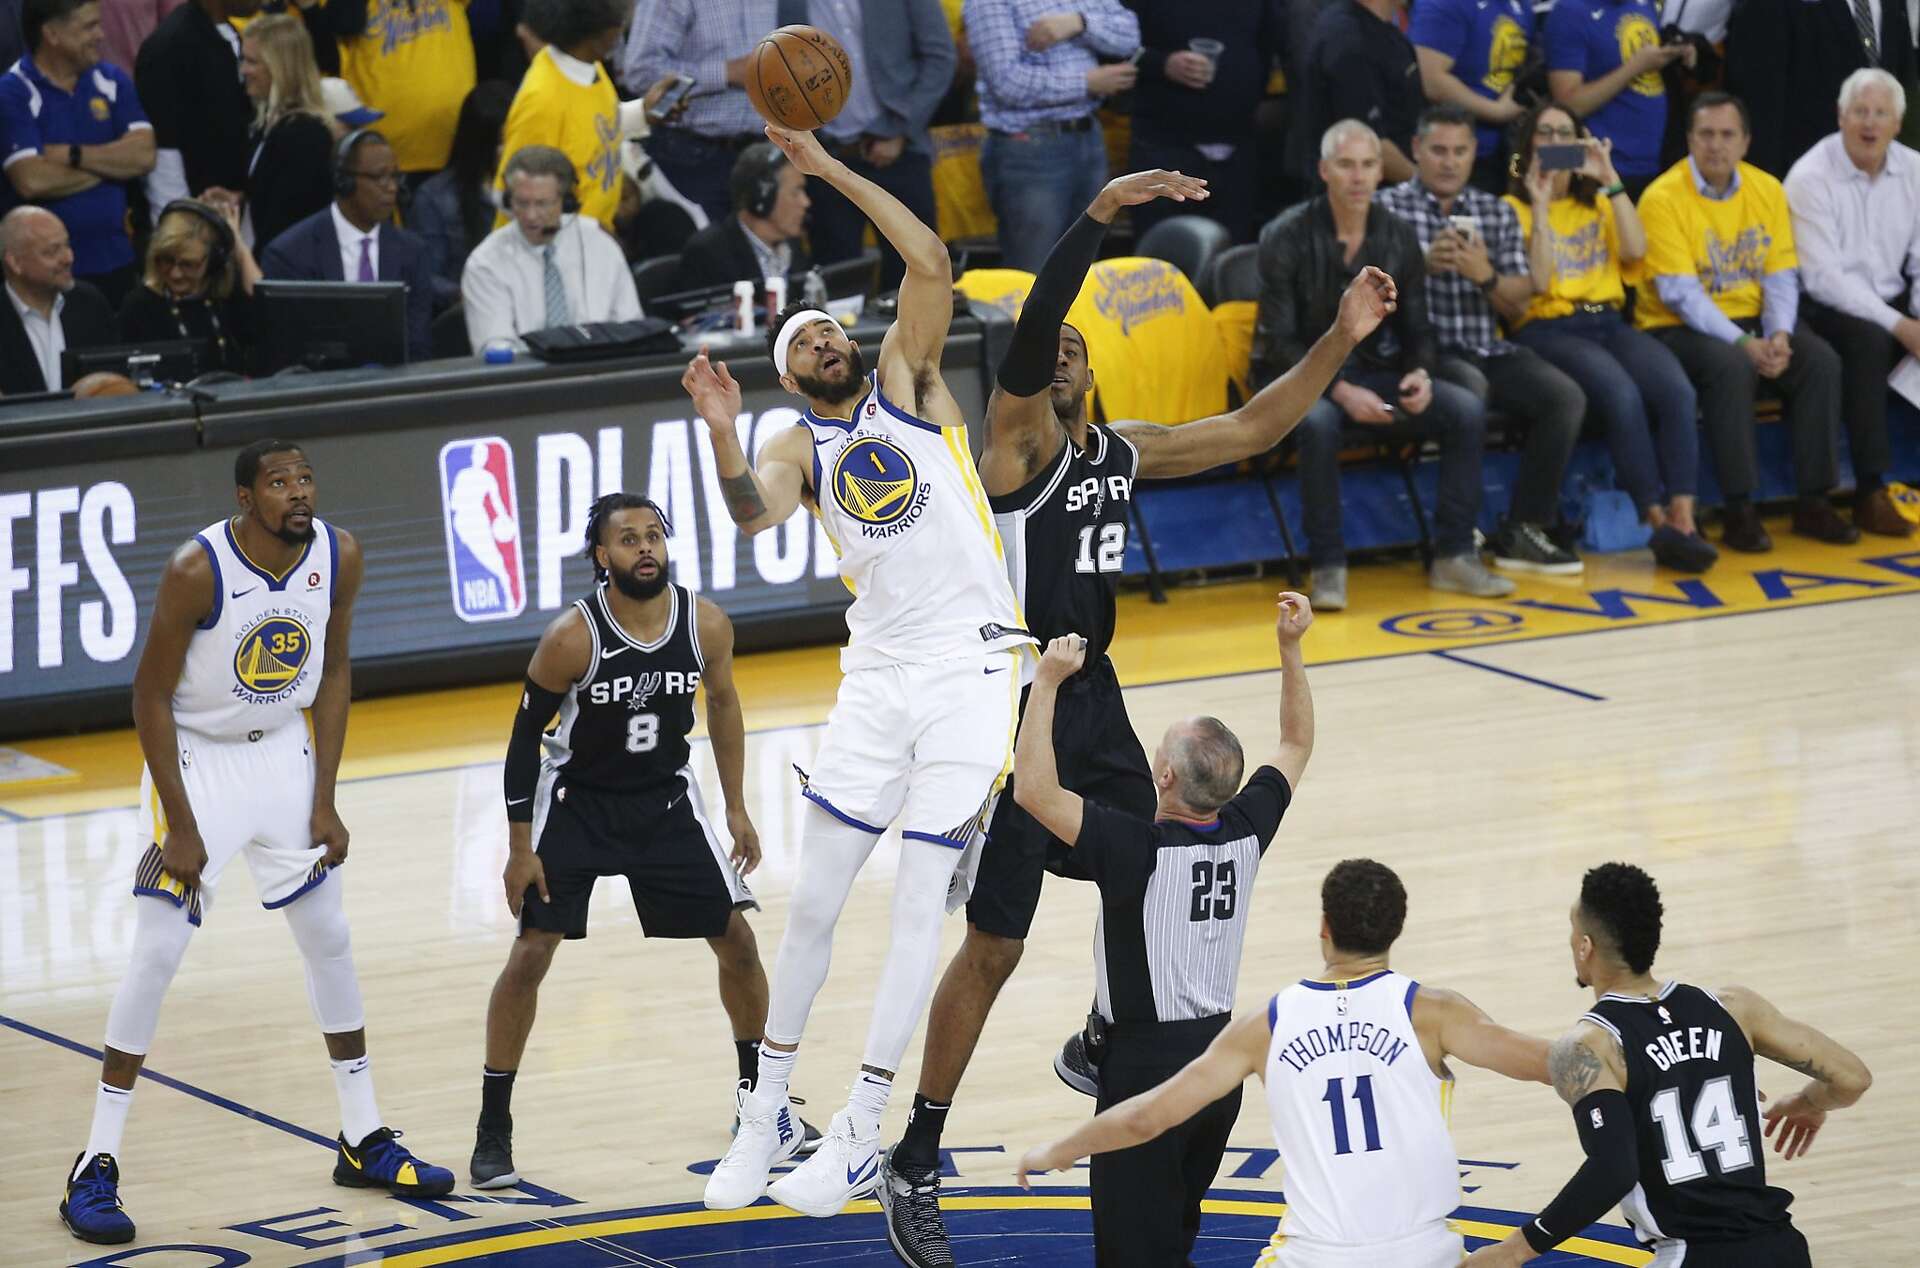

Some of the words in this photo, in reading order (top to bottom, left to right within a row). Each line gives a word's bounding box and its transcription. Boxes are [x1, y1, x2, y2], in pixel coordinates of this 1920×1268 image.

[869, 451, 887, 474] 1
[862, 481, 932, 539] WARRIORS
[1075, 522, 1126, 573] 12
[464, 578, 501, 609] NBA
[235, 608, 280, 641] GOLDEN
[285, 607, 314, 628] STATE
[271, 631, 301, 655] 35
[231, 671, 309, 705] WARRIORS
[625, 713, 660, 754] 8
[1190, 859, 1237, 922] 23
[1278, 1021, 1409, 1073] THOMPSON
[1645, 1026, 1723, 1072] GREEN
[776, 1106, 794, 1146] NIKE
[1321, 1074, 1384, 1156] 11
[1649, 1074, 1755, 1186] 14
